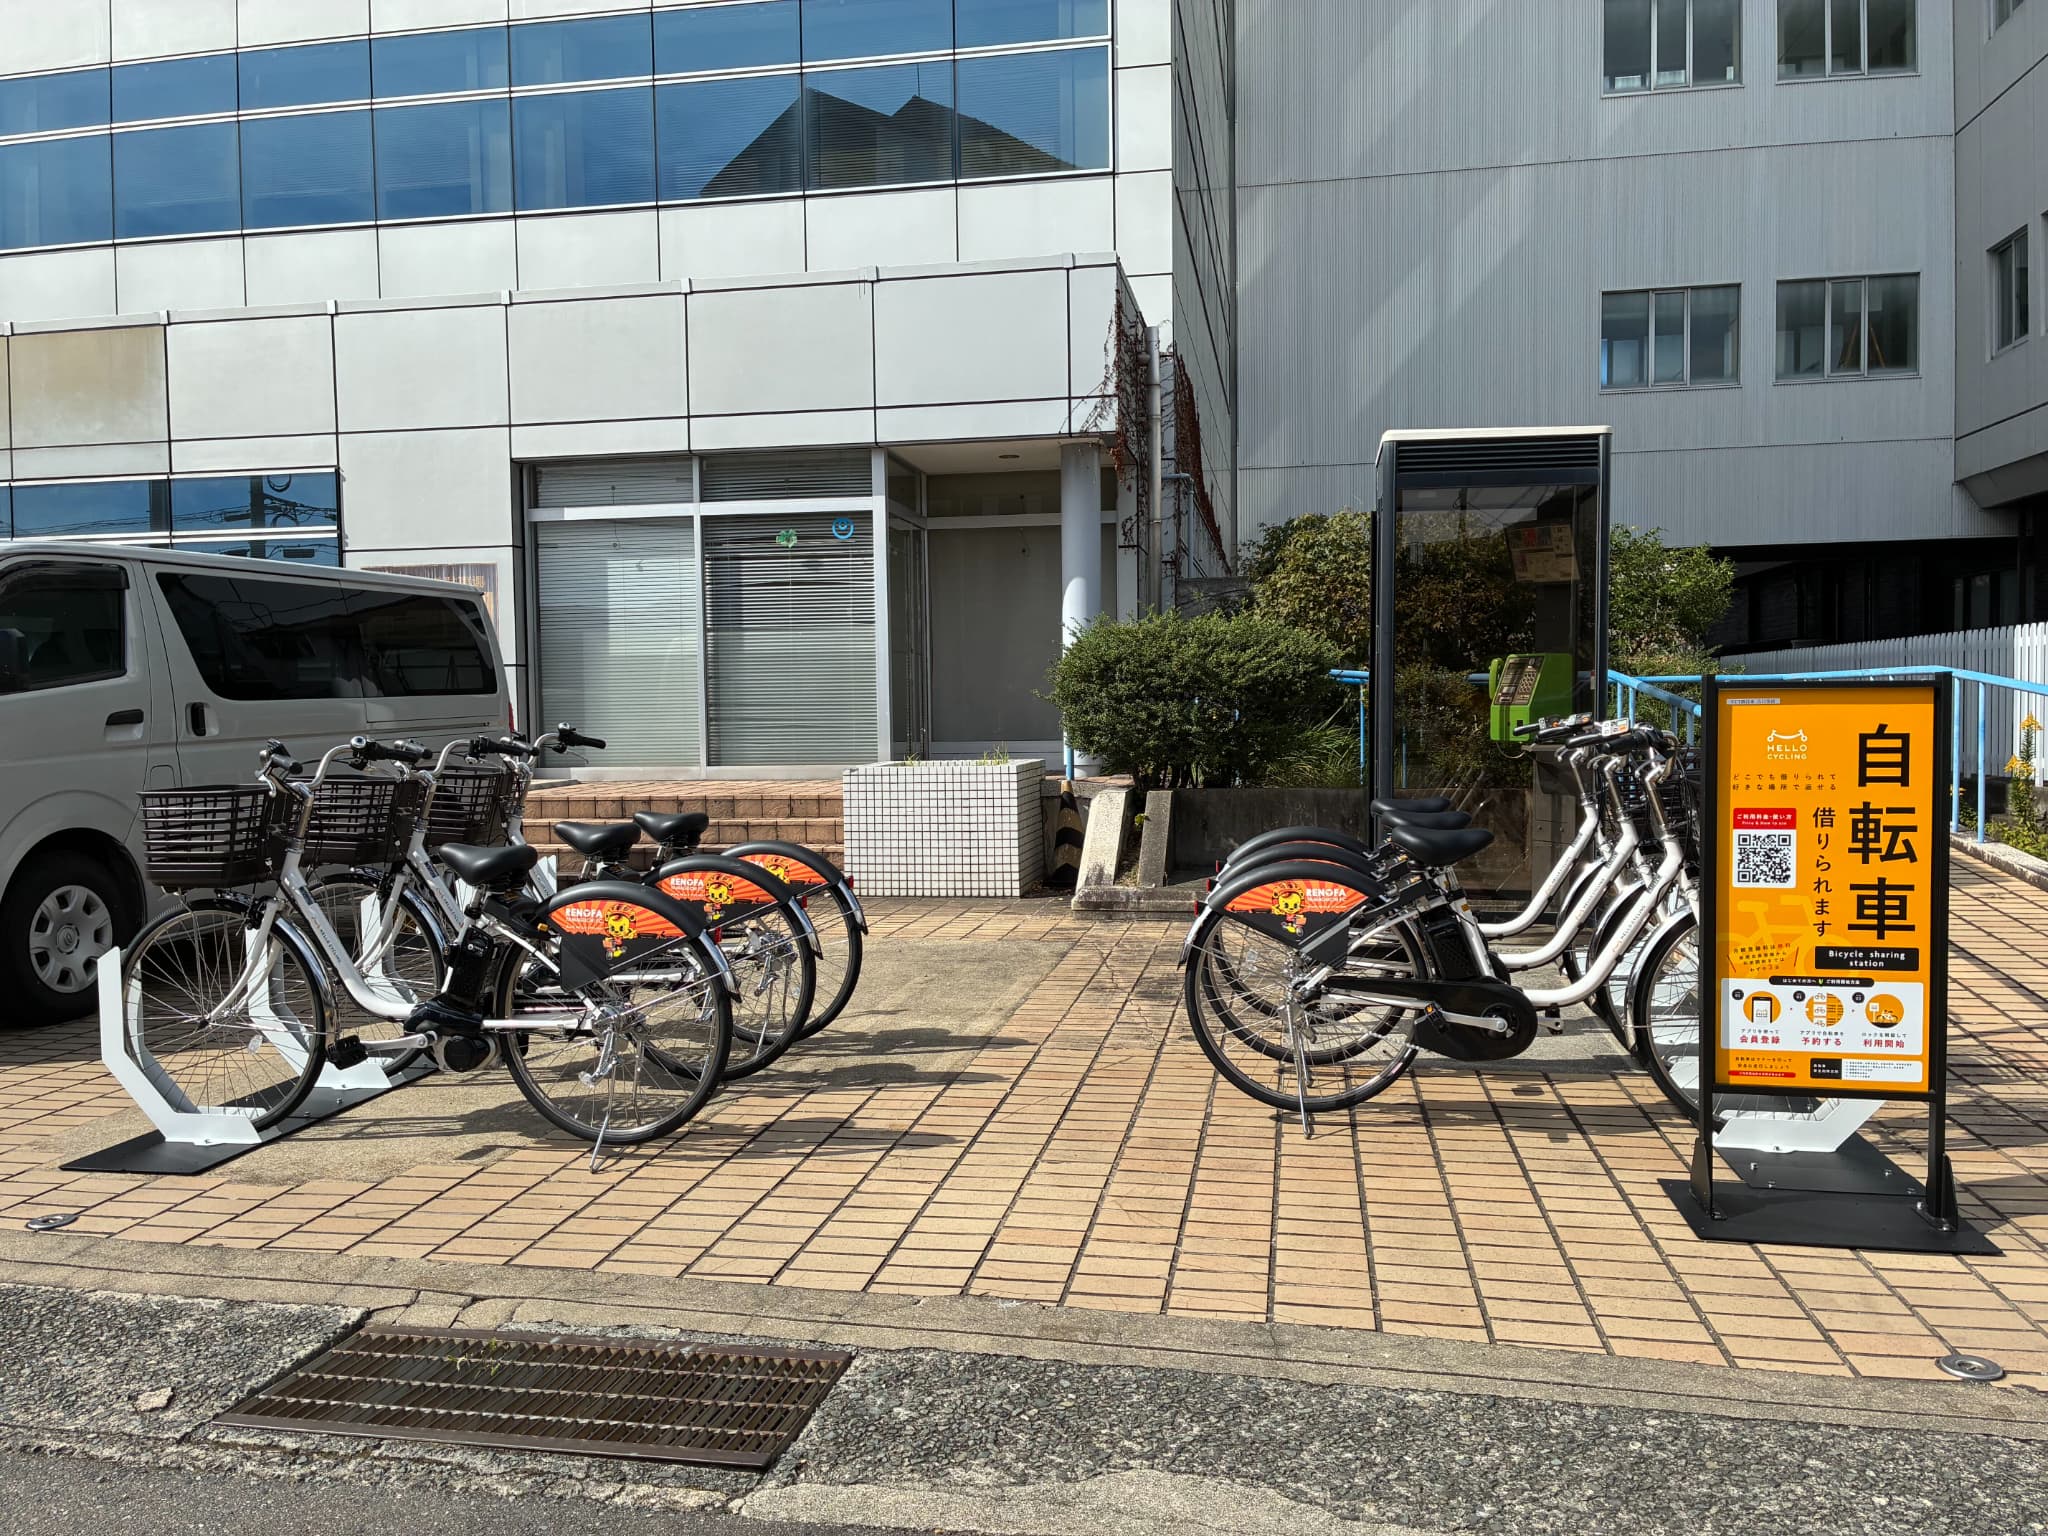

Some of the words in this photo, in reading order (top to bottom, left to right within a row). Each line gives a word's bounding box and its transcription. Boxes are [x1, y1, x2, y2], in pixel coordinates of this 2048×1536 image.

[1767, 744, 1808, 752] HELLO
[1847, 723, 1918, 940] 自転車
[1812, 806, 1836, 937] 借りられます
[671, 878, 704, 886] RENOFA
[1306, 888, 1346, 897] RENOFA
[565, 908, 603, 918] RENOFA
[1828, 950, 1864, 959] Bicycle
[1869, 951, 1906, 961] sharing
[1740, 1035, 1780, 1045] 会員登録
[1802, 1037, 1842, 1046] 予約する
[1864, 1039, 1905, 1049] 利用開始
